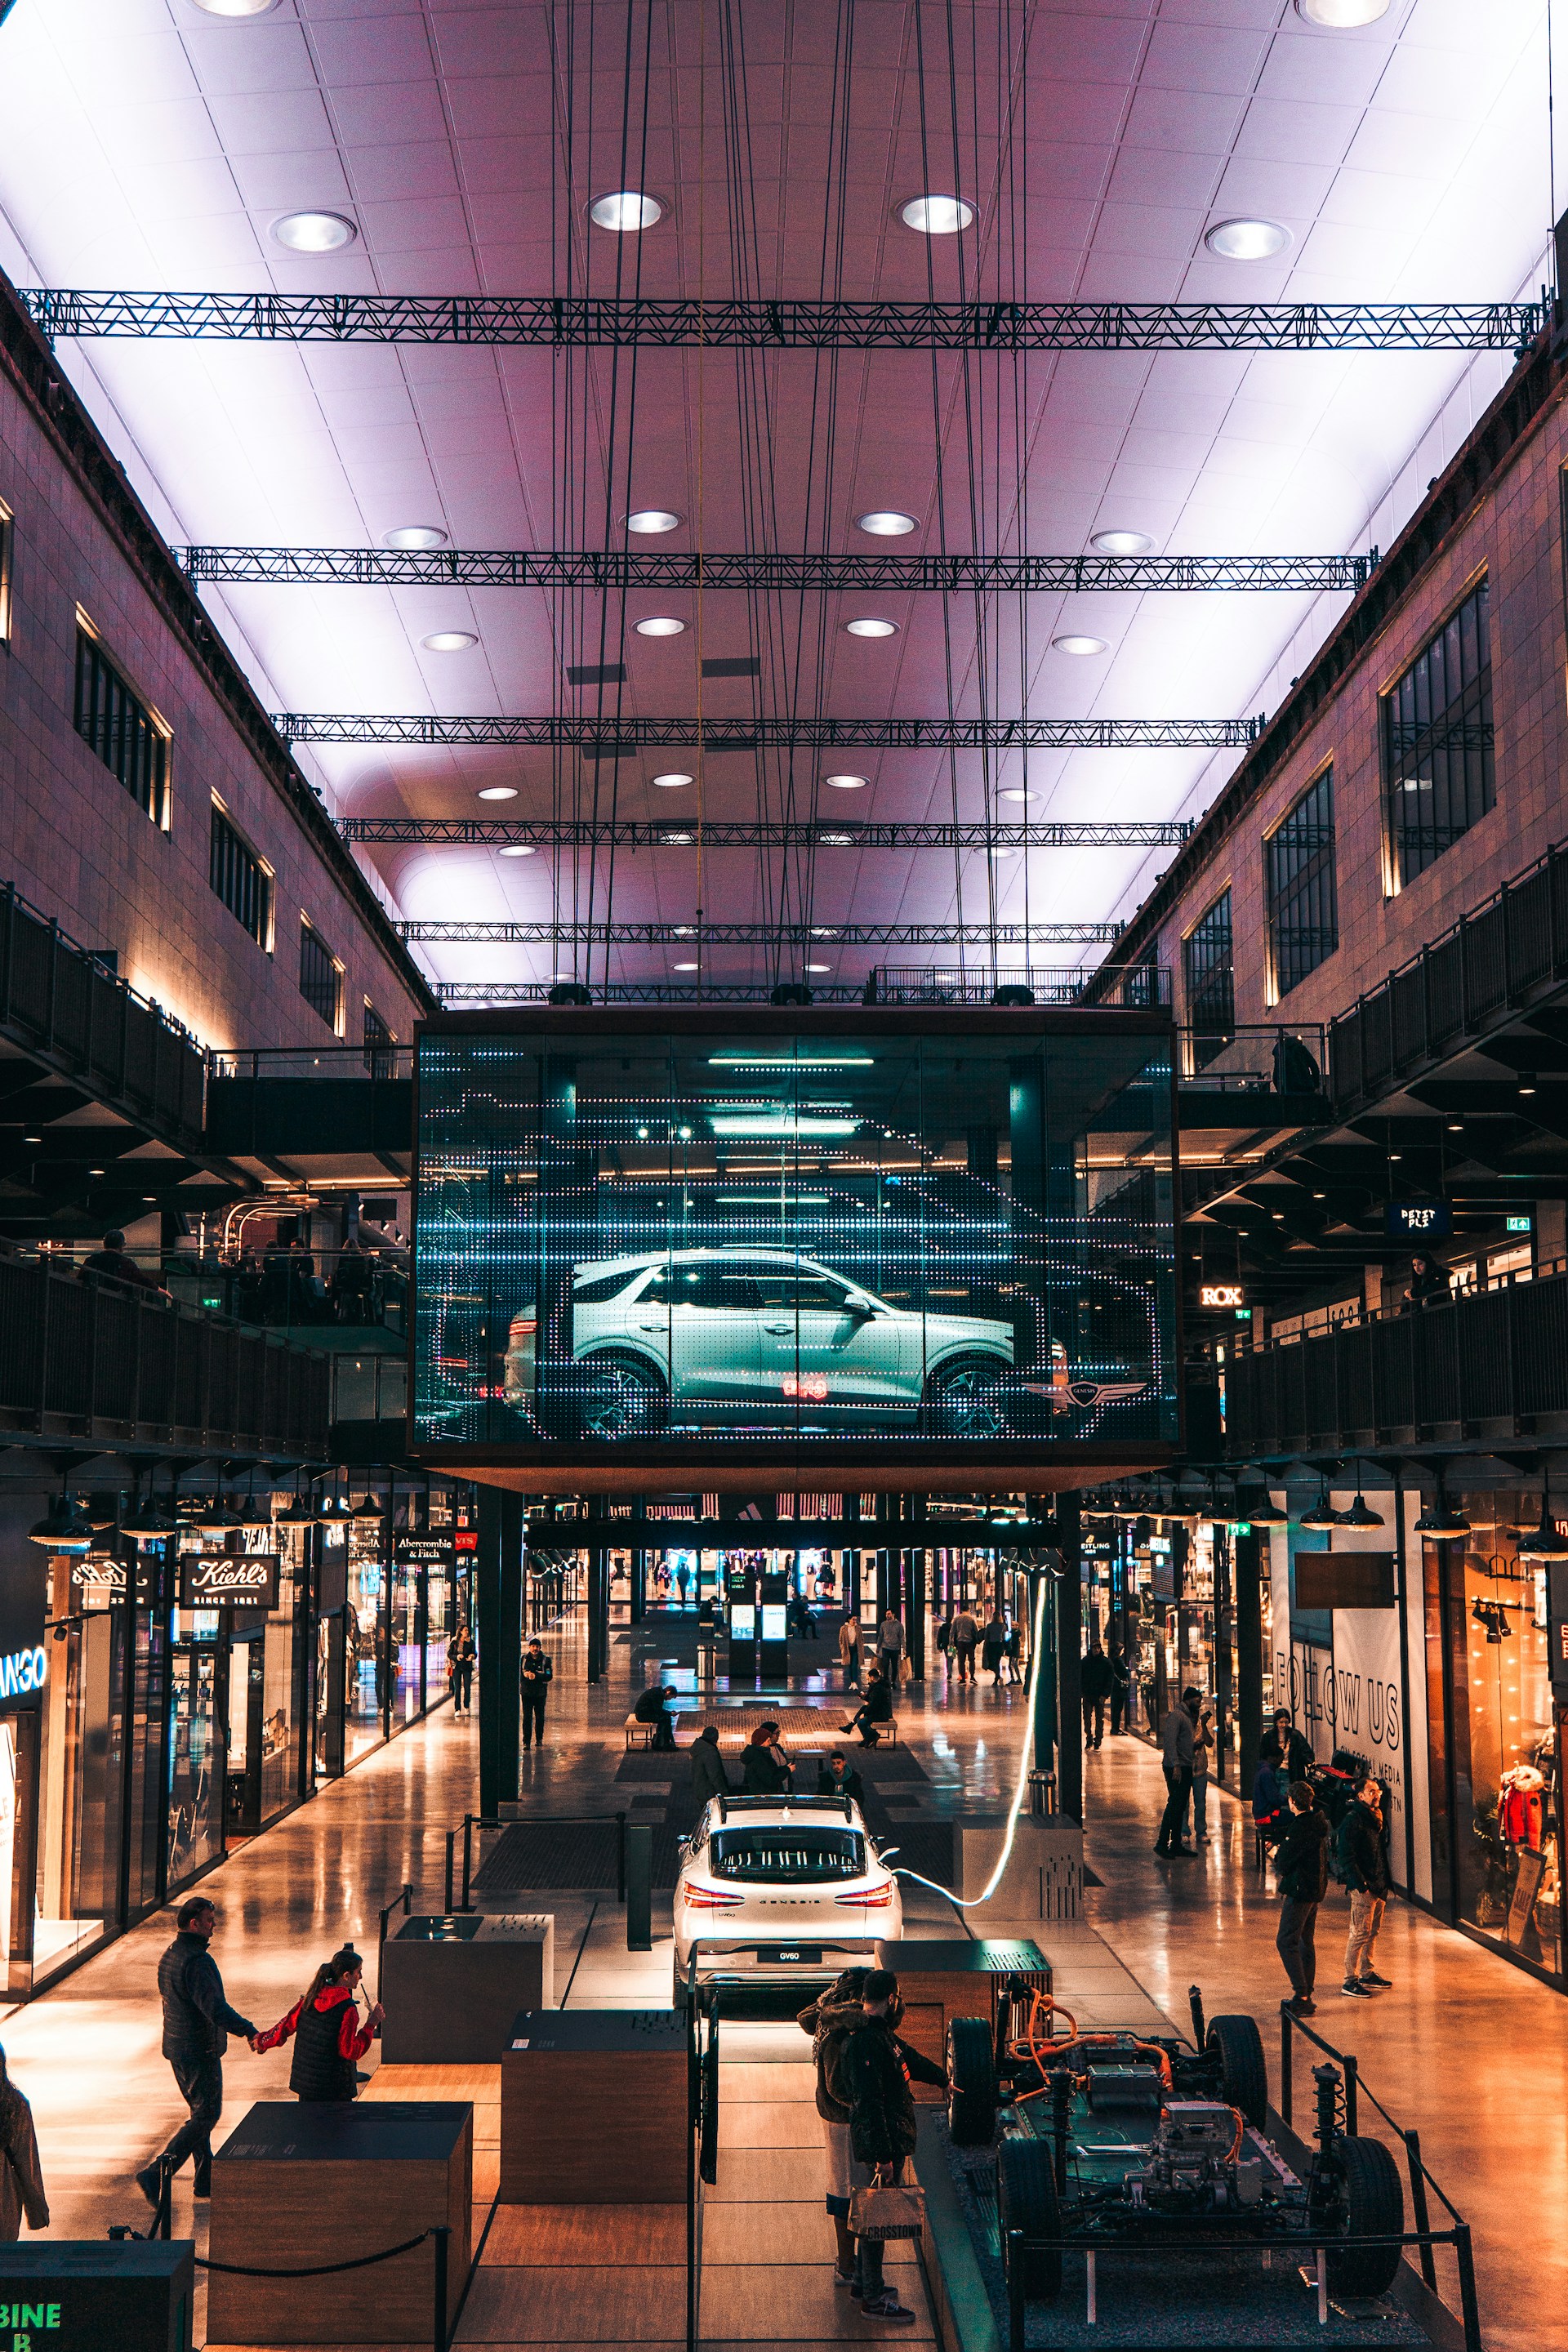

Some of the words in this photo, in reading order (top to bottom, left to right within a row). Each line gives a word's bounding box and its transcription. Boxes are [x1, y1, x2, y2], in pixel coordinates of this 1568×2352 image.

[1401, 1209, 1435, 1218] PETIT
[1409, 1218, 1428, 1227] PLI
[1201, 1287, 1242, 1306] ROX
[399, 1539, 452, 1548] Abercrombie
[409, 1550, 417, 1558] &
[418, 1549, 440, 1558] Fitch
[191, 1561, 268, 1587] Kiehl's
[193, 1597, 225, 1605] SINCE
[234, 1597, 258, 1605] 1851
[1277, 1651, 1360, 1735] FOLLOW
[1368, 1678, 1400, 1750] US
[1379, 1762, 1401, 1786] MEDIA
[780, 1952, 800, 1960] GV60
[868, 2224, 922, 2240] CROSSTOWN
